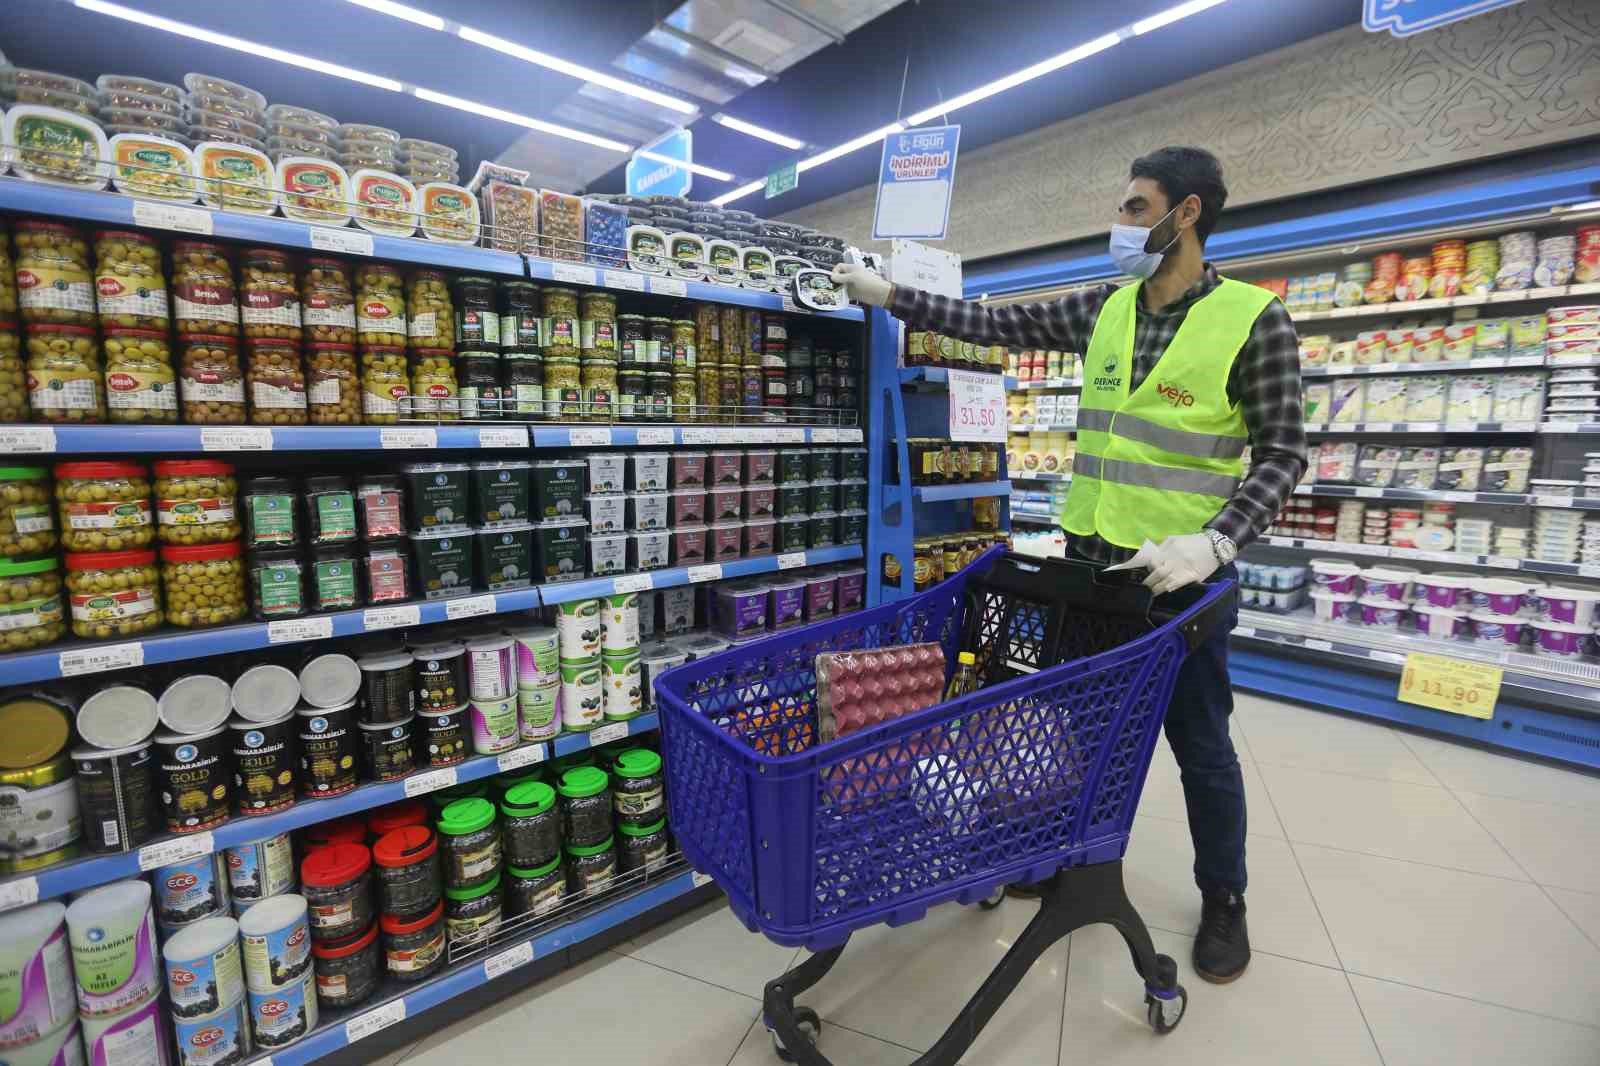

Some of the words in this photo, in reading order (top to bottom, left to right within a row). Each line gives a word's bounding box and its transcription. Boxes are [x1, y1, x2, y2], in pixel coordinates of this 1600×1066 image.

[170, 768, 209, 784] GOLD
[167, 875, 194, 888] ECE
[260, 1000, 288, 1014] ECE
